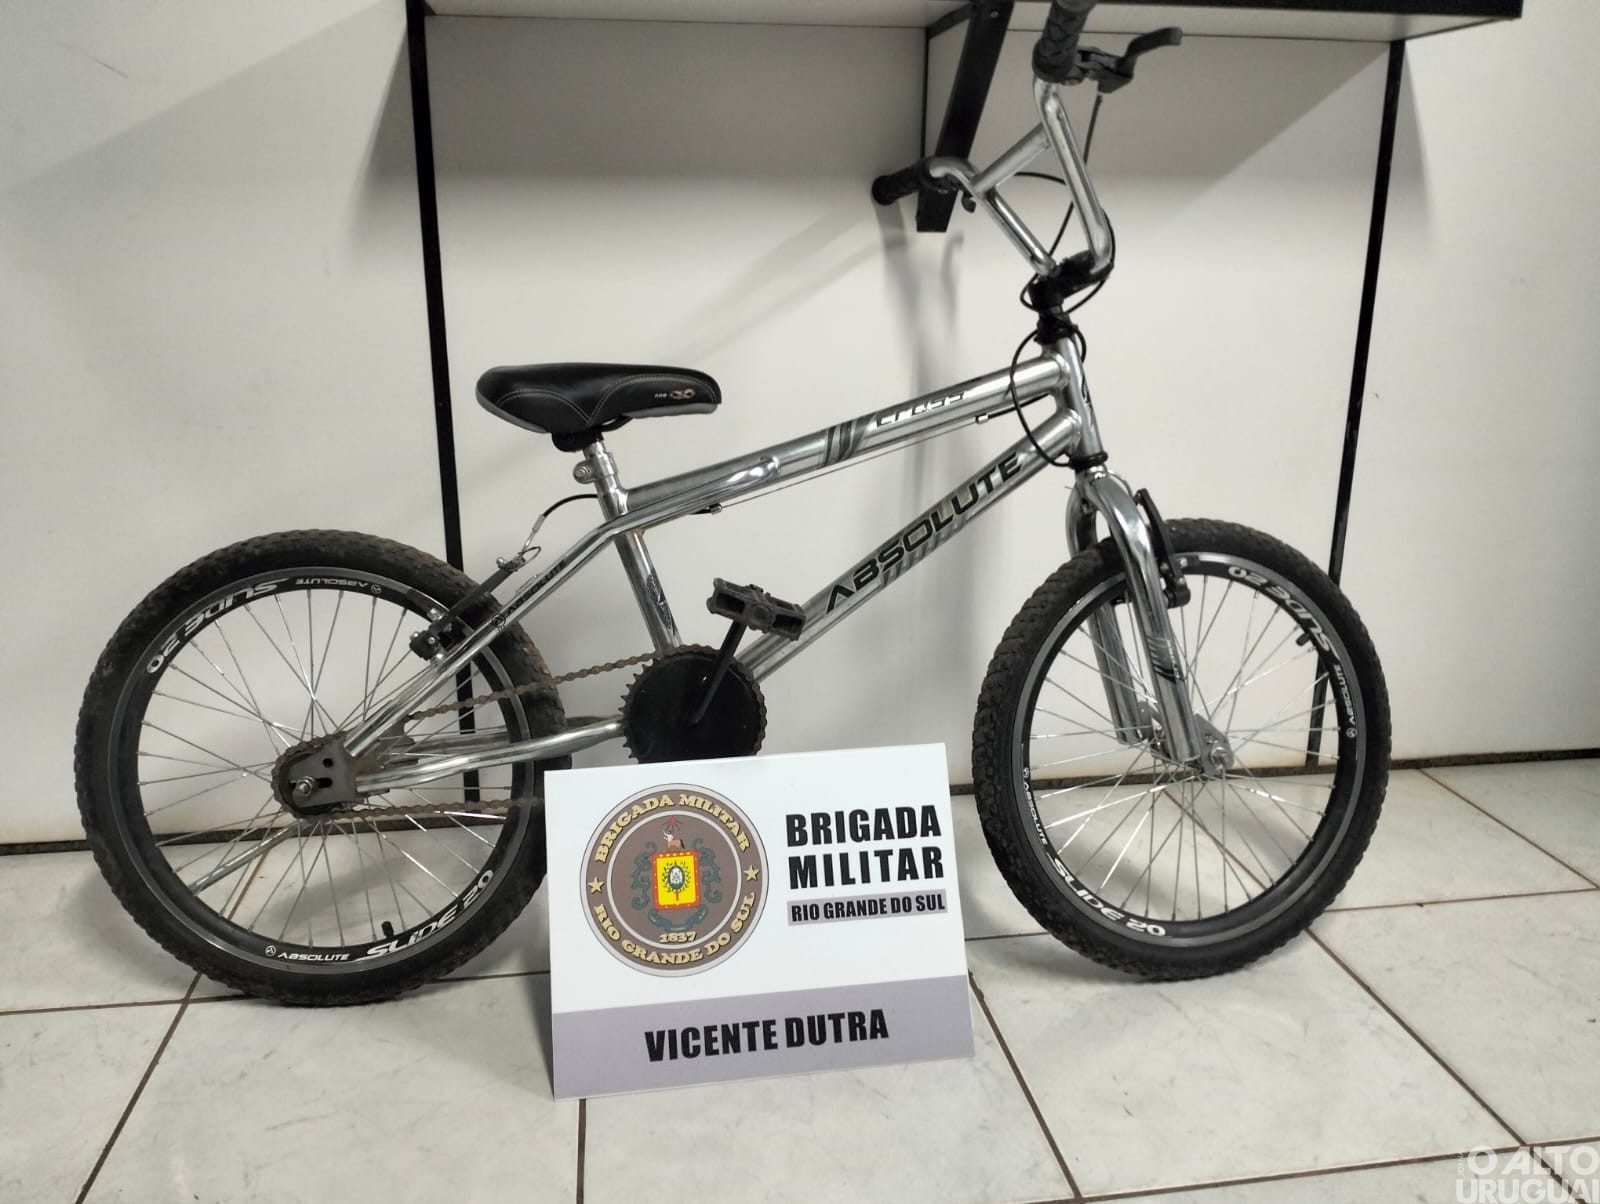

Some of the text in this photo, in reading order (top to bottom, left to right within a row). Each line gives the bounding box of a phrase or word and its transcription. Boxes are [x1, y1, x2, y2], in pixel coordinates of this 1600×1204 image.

[826, 451, 1024, 615] ABSOLUTE
[295, 577, 369, 588] ABSOLUTE
[1228, 565, 1269, 587] 20
[146, 630, 182, 674] 20
[594, 793, 751, 864] BRIGADA MILITAR
[785, 804, 942, 847] BRIGADA
[788, 846, 944, 890] MILITAR
[277, 869, 495, 963] ABSOLUTE SLIDE 20
[594, 891, 757, 965] RIO GRANDE DO SUL
[791, 894, 946, 922] RIO GRANDE DO SUL
[1125, 918, 1167, 937] 20
[658, 931, 698, 944] 1837
[644, 1008, 890, 1062] VICENTE DUTRA
